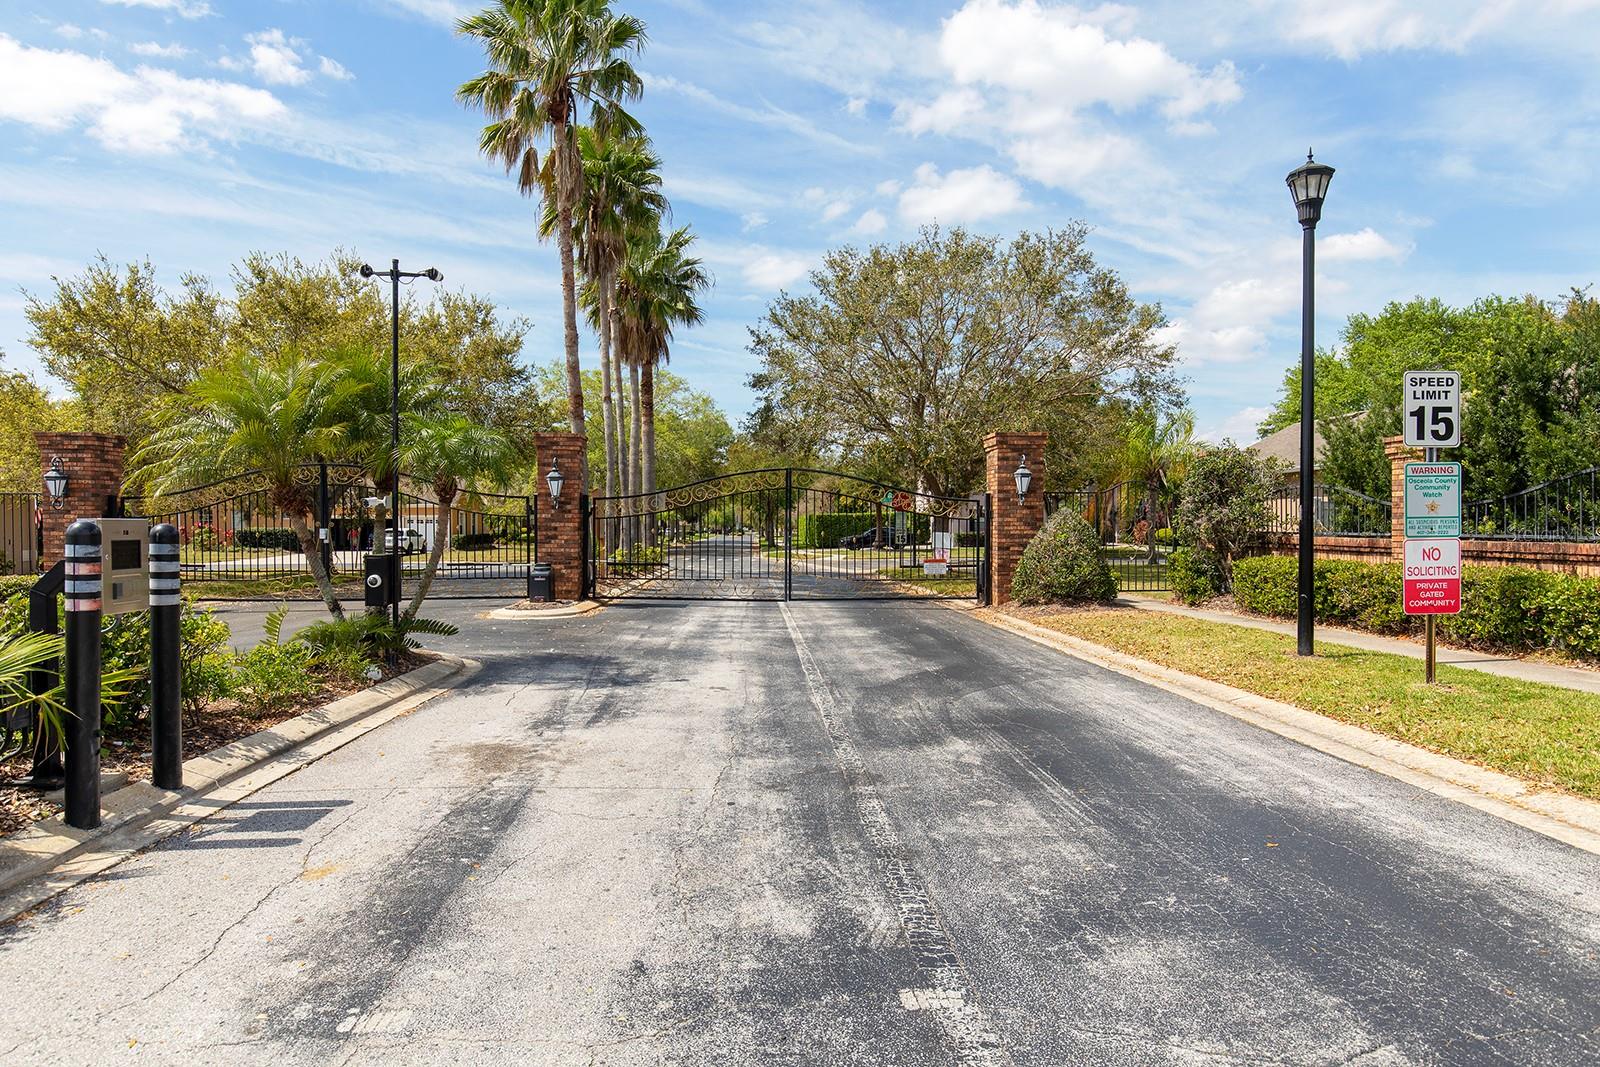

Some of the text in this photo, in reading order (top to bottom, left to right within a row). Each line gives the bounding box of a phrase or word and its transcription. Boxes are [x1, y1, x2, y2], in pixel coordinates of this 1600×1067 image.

[1410, 377, 1454, 387] SPEED
[1413, 390, 1451, 400] LIMIT
[1409, 406, 1454, 441] 15
[1411, 466, 1454, 474] WARNING
[1422, 547, 1441, 561] NO
[1407, 566, 1457, 577] SOLICITING
[1409, 599, 1456, 607] COMMUNITY
